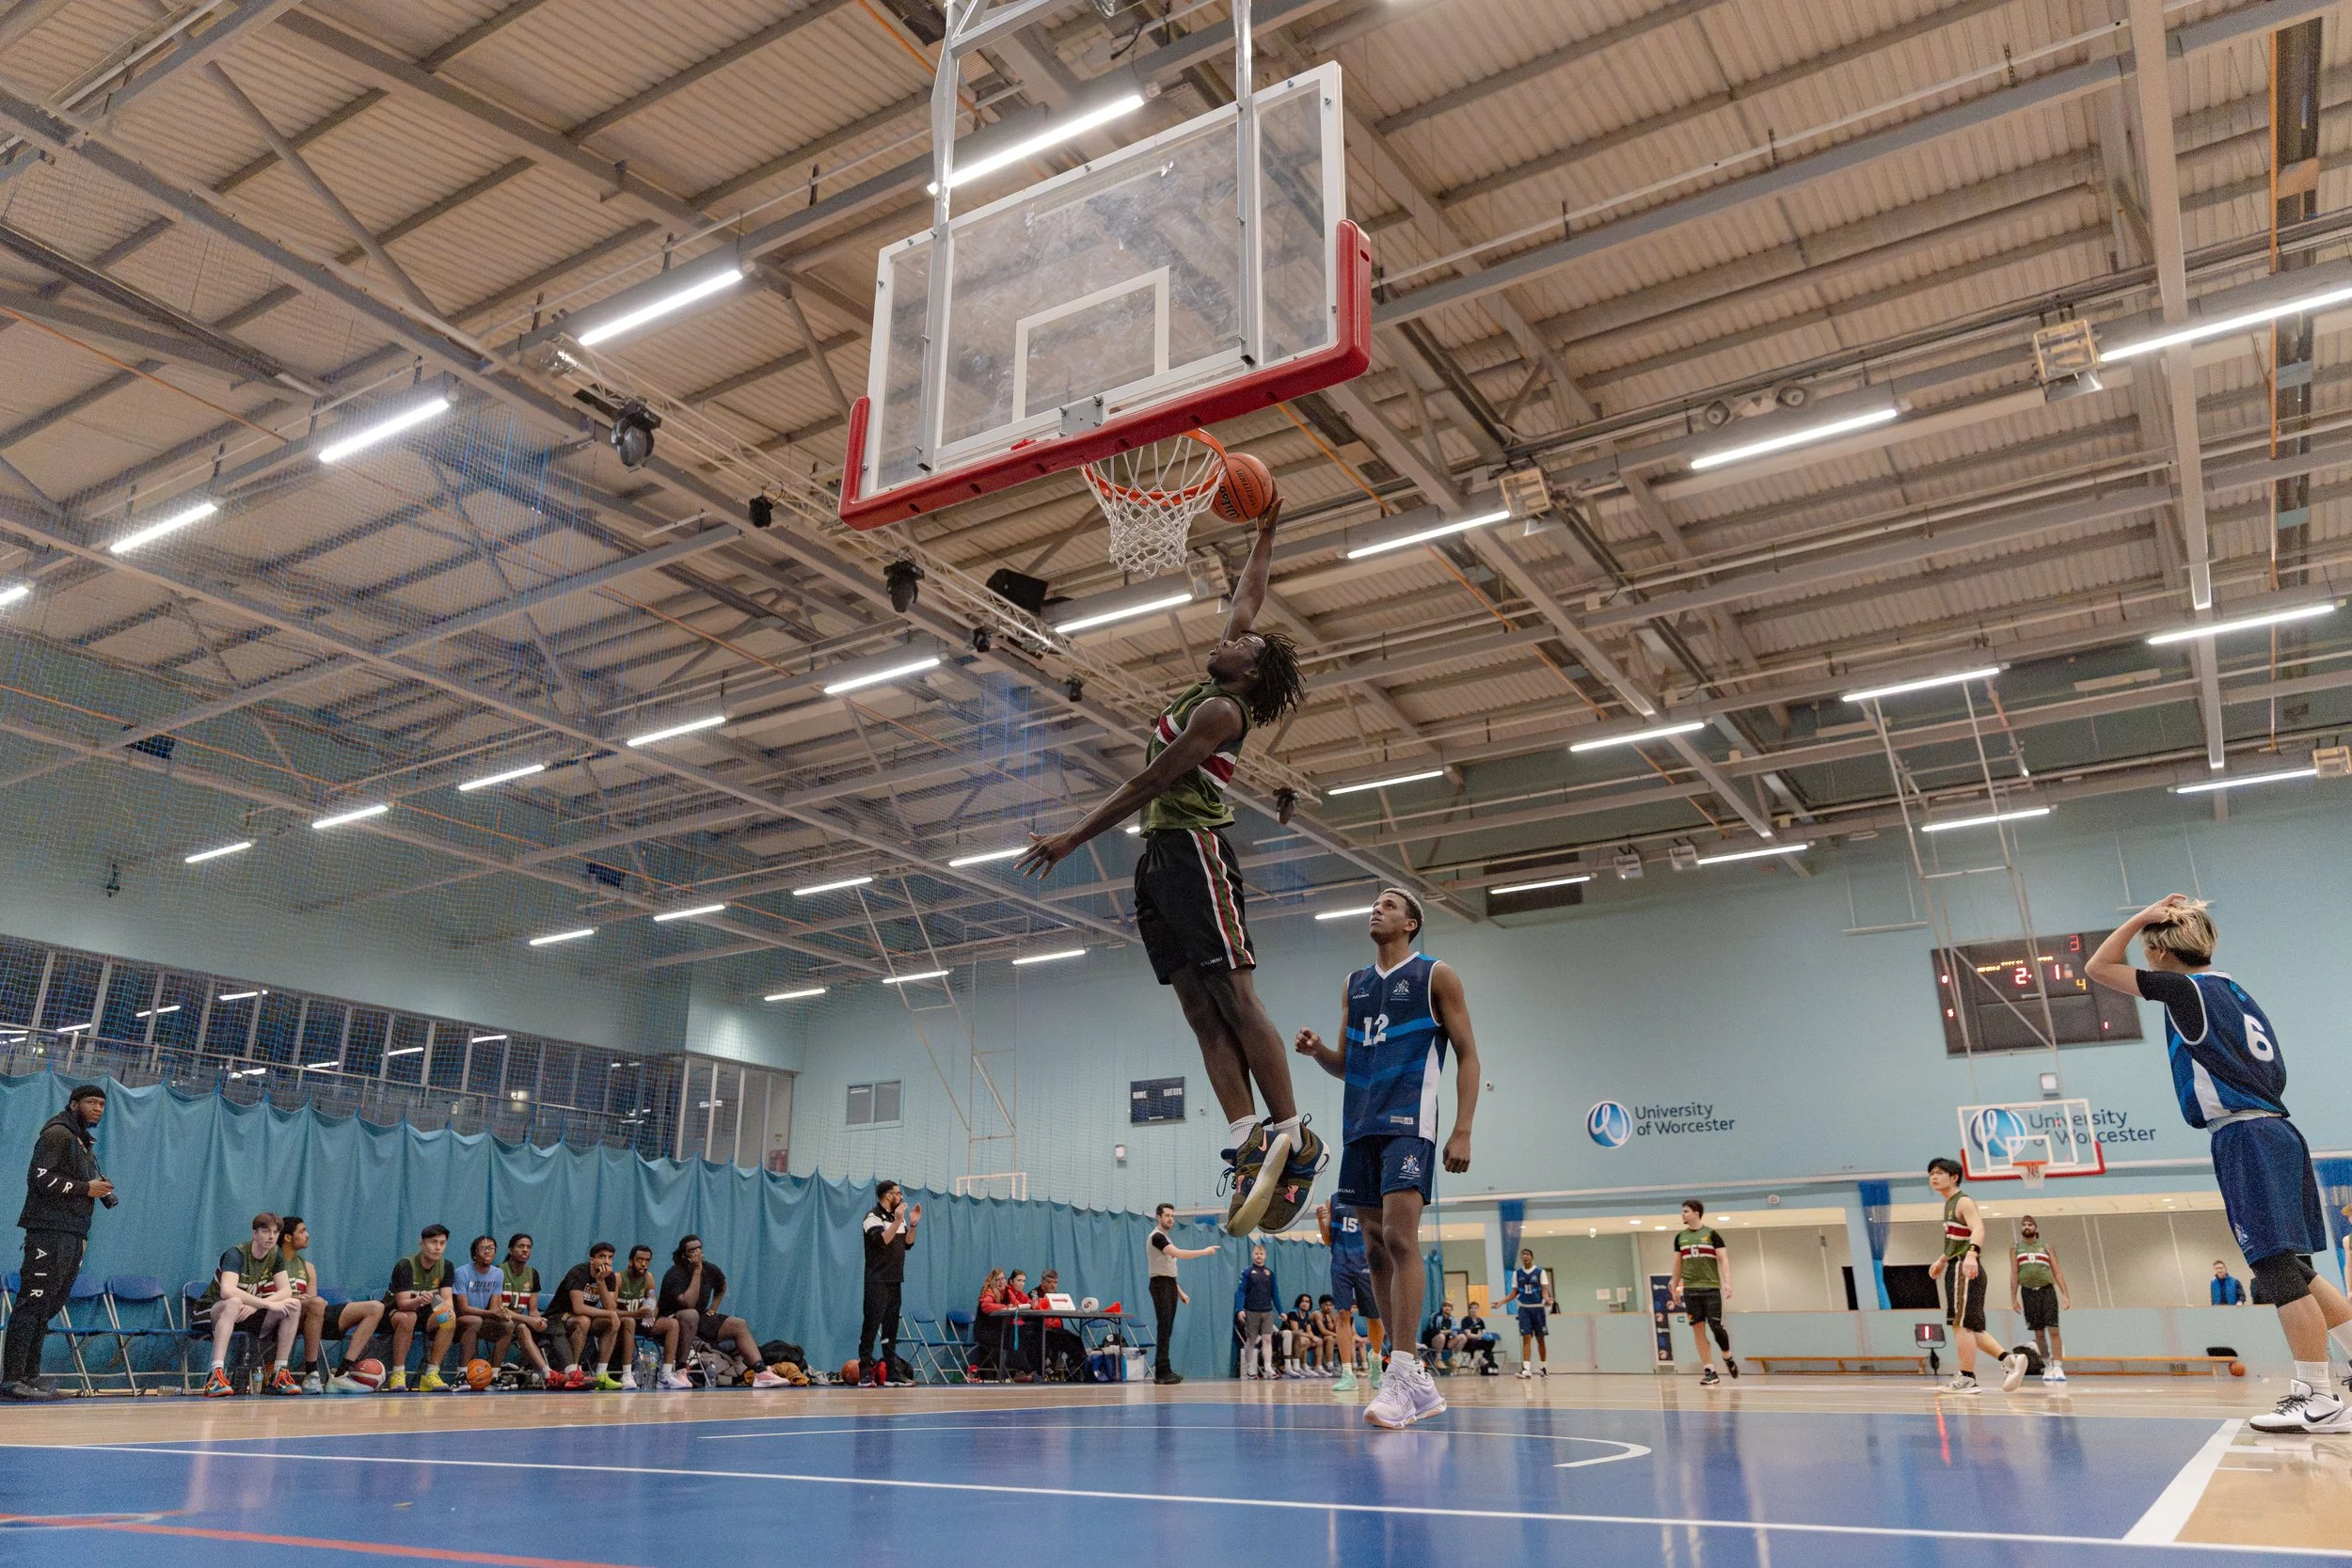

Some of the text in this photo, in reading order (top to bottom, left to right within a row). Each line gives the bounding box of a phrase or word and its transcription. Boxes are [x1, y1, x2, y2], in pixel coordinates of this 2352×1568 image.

[1219, 484, 1240, 518] Wilso
[1362, 1013, 1390, 1047] 12
[2243, 1013, 2275, 1062] 6
[1634, 1102, 1713, 1119] University
[1636, 1118, 1736, 1136] of Worcester
[37, 1167, 73, 1194] AIR
[1342, 1216, 1359, 1233] 15
[1690, 1243, 1700, 1258] 6
[29, 1247, 48, 1298] AIR
